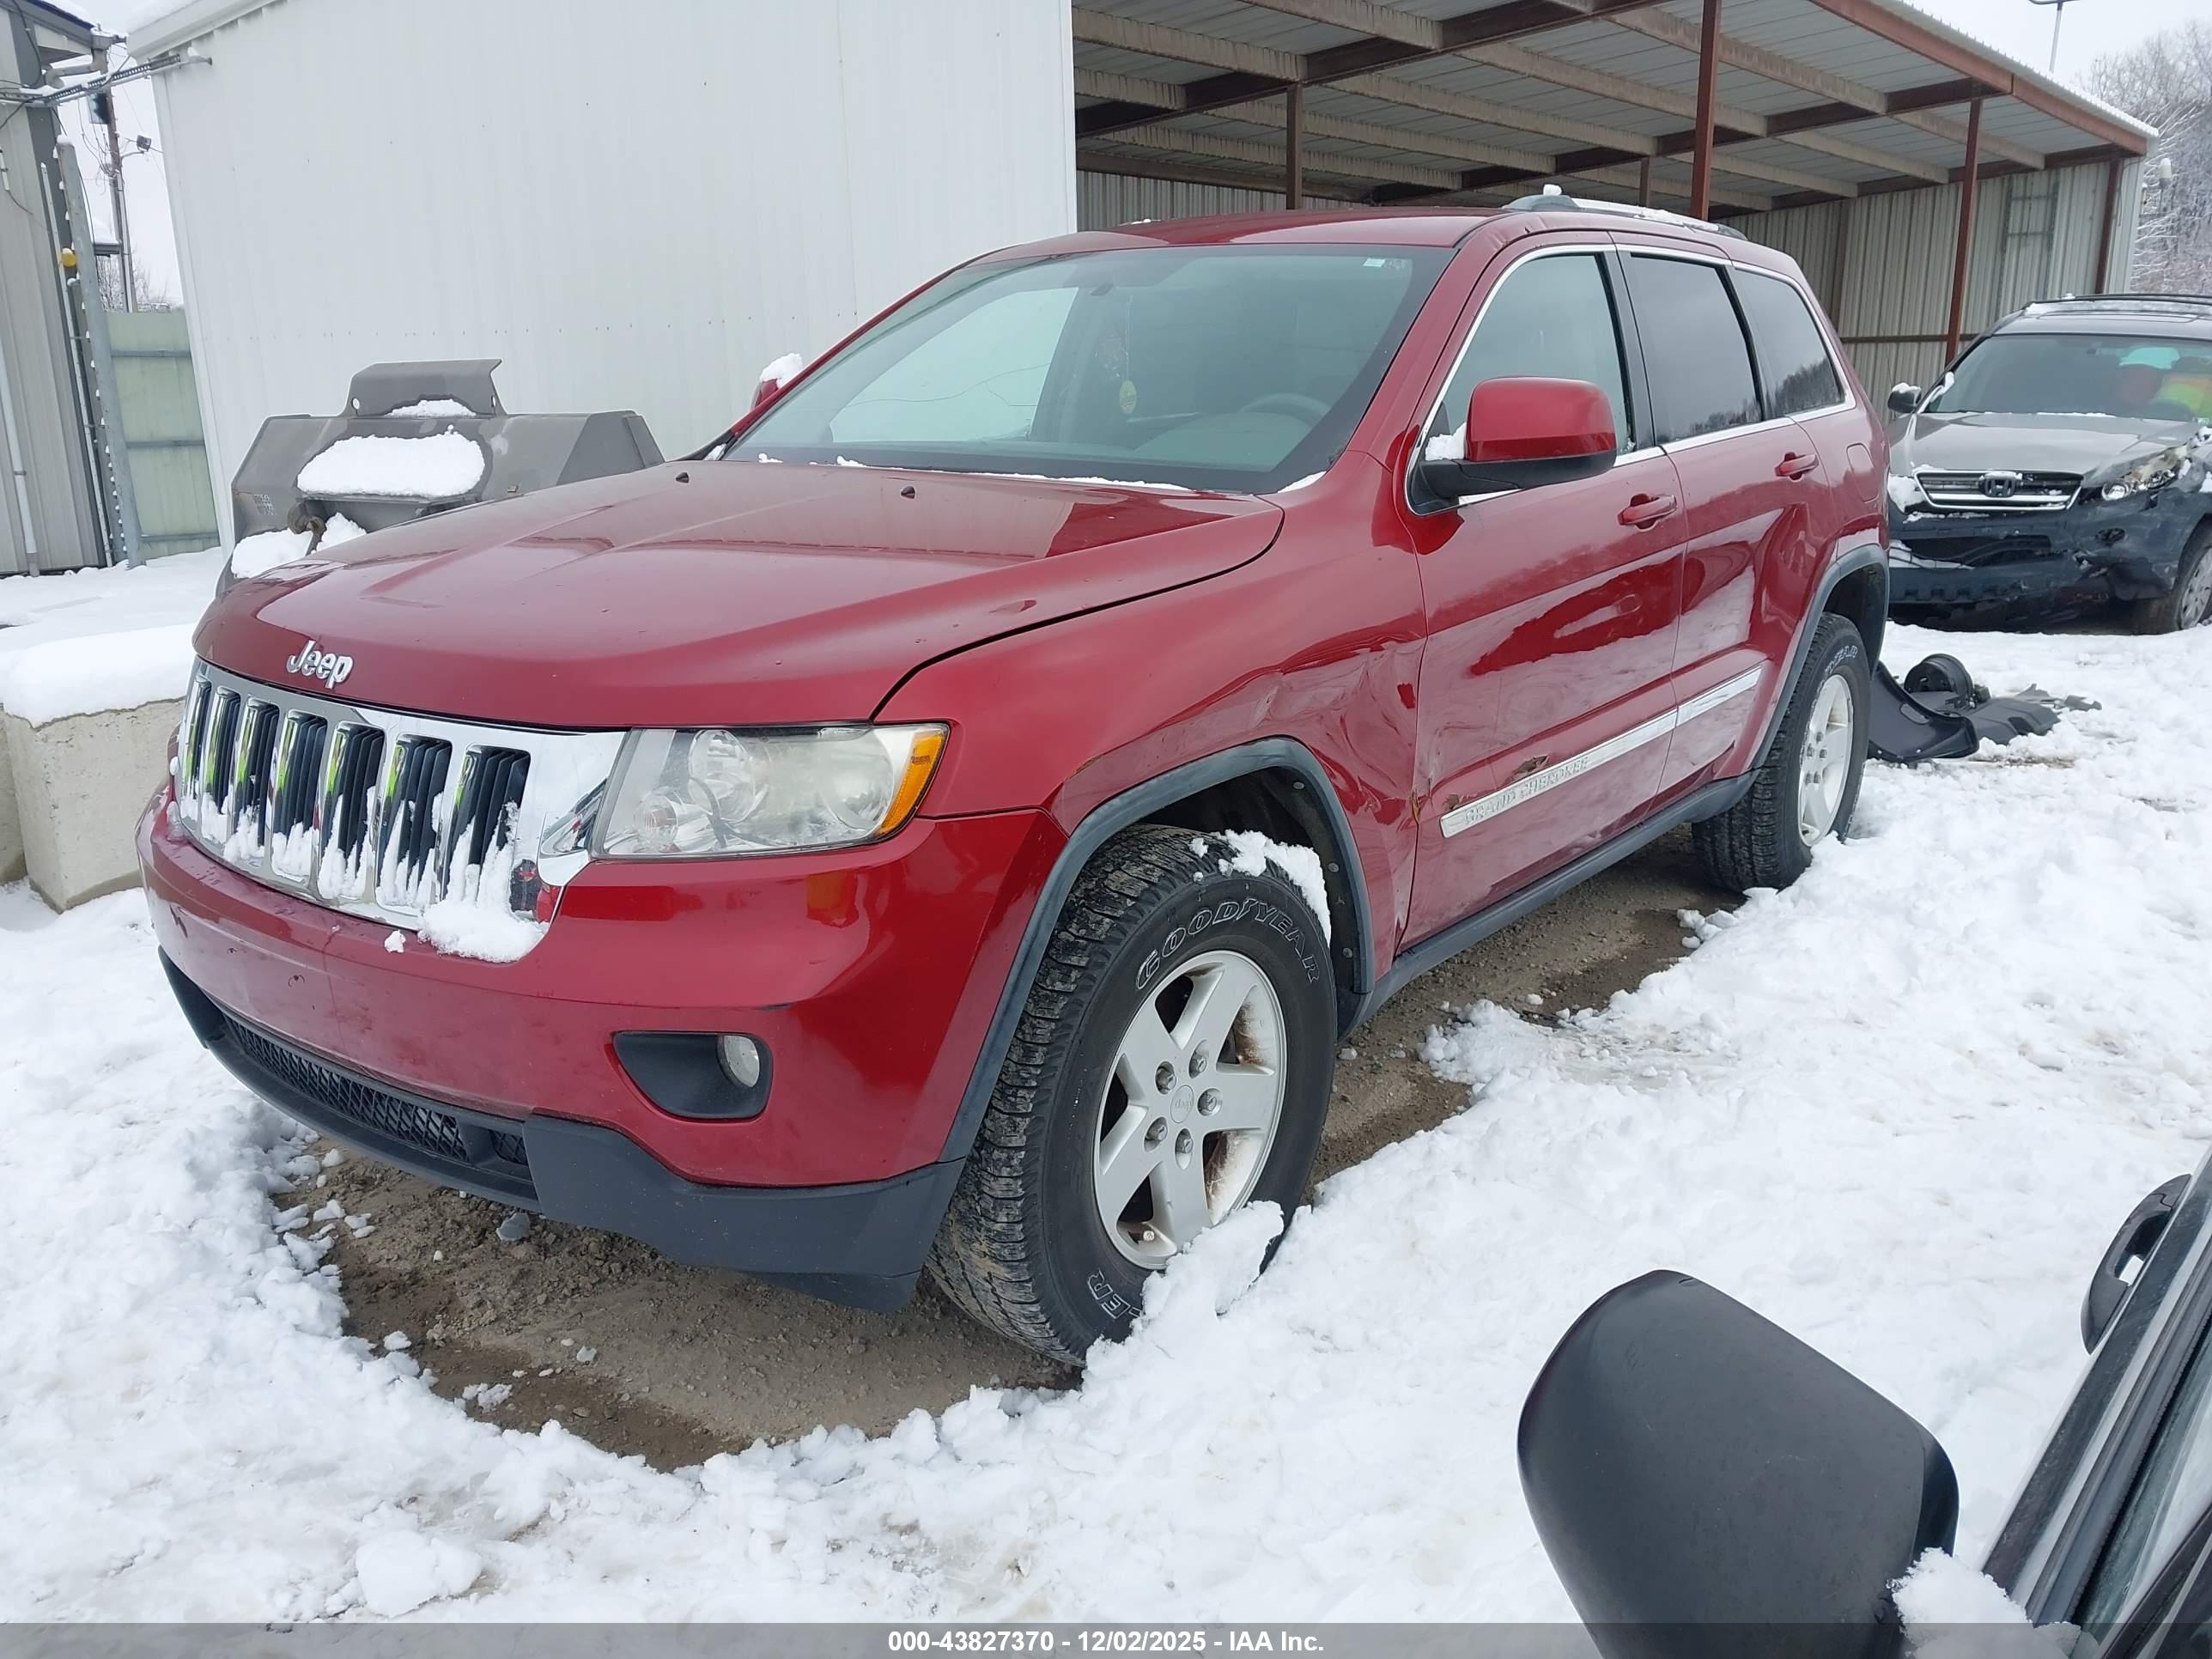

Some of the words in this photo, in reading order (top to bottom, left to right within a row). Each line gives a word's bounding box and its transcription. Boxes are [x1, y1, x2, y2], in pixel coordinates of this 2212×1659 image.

[286, 640, 354, 690] Jeep
[1464, 788, 1516, 825] GRAND
[1520, 756, 1589, 799] CHEROKEE
[1136, 898, 1320, 989] GOODYEAR
